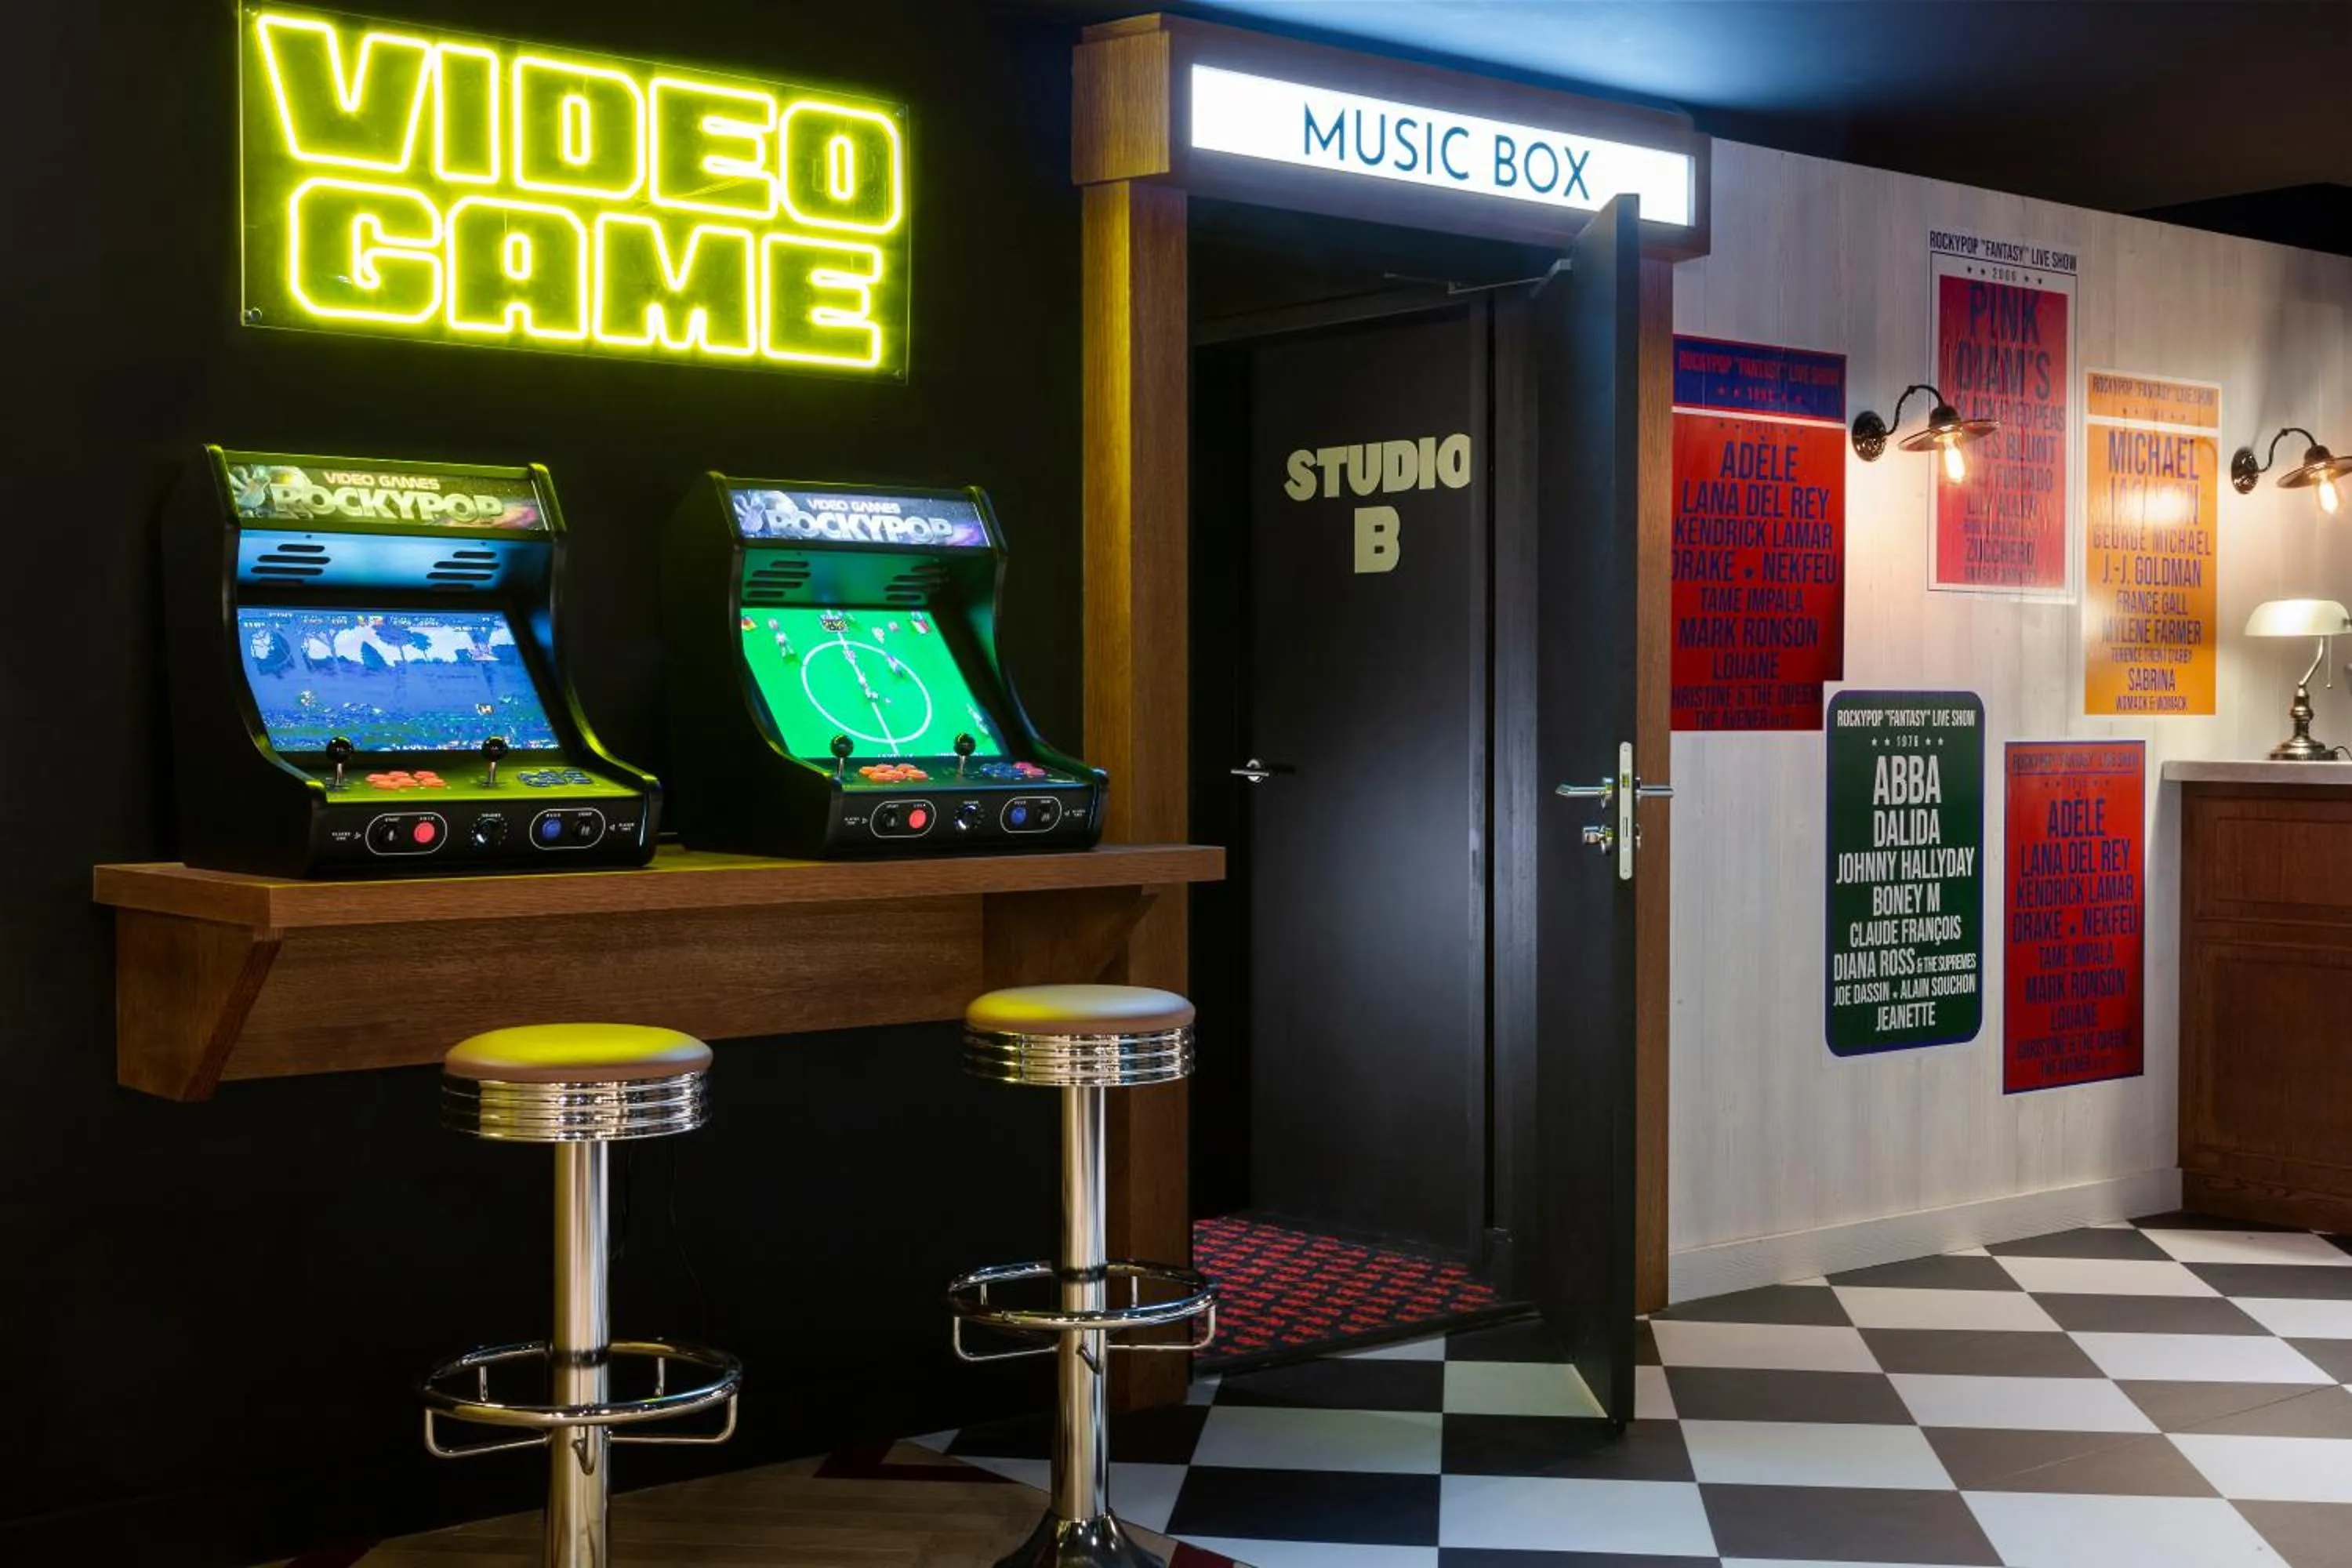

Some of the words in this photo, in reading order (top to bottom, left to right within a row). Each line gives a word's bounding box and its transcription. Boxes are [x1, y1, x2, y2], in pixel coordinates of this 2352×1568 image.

[256, 14, 902, 234] VIDEO
[1305, 102, 1469, 180] MUSIC
[1494, 134, 1591, 200] BOX
[1929, 230, 1979, 254] ROCKYPOP
[2031, 248, 2049, 267] LIVE
[2052, 251, 2077, 271] SHOW
[289, 176, 884, 368] GAME
[1969, 281, 2041, 344] PINK
[1283, 434, 1471, 501] STUDIO
[2109, 430, 2200, 481] MICHAEL
[323, 472, 375, 485] VIDEO
[379, 474, 441, 490] GAMES
[270, 482, 503, 521] ROCKYPOP
[808, 499, 848, 510] VIDEO
[851, 500, 901, 514] GAMES
[1682, 480, 1739, 516] LANA
[1746, 484, 1784, 517] DEL
[1791, 486, 1829, 520] REY
[768, 510, 953, 543] ROCKYPOP
[1355, 506, 1400, 573] B
[1674, 516, 1767, 547] KENDRICK
[1773, 521, 1833, 548] LAMAR
[2152, 528, 2211, 556] MICHAEL
[1762, 552, 1837, 584] NEKFEU
[2135, 555, 2201, 587] GOLDMAN
[1700, 587, 1740, 612] TAME
[1746, 588, 1806, 613] IMPALA
[2117, 590, 2158, 615] FRANCE
[2162, 592, 2188, 615] GALL
[1678, 617, 1737, 648] MARK
[1742, 617, 1819, 649] RONSON
[2154, 619, 2201, 645] FARMER
[1711, 652, 1780, 680] LOUANE
[2128, 668, 2176, 691] SABRINA
[1837, 710, 1882, 728] ROCKYPOP
[1885, 710, 1931, 727] "FANTASY"
[1933, 710, 1950, 727] LIVE
[1951, 710, 1976, 727] SHOW
[1872, 755, 1941, 805] ABBA
[1874, 809, 1941, 848] DALIDA
[1835, 851, 1897, 884] JOHNNY
[1901, 847, 1975, 880] HALLYDAY
[2021, 842, 2063, 877] LANA
[2068, 840, 2096, 874] DEL
[2100, 839, 2131, 873] REY
[1873, 884, 1923, 916] BONEY
[1926, 883, 1940, 912] M
[2016, 877, 2084, 908] KENDRICK
[2089, 874, 2133, 903] LAMAR
[1849, 920, 1898, 947] CLAUDE
[1901, 916, 1962, 946] FRANÇOIS
[2013, 910, 2063, 943] DRAKE
[2082, 904, 2137, 936] NEKFEU
[1834, 951, 1876, 981] DIANA
[1880, 947, 1915, 976] ROSS
[1923, 956, 1936, 972] THE
[1938, 953, 1976, 971] SUPREMES
[1833, 985, 1851, 1007] JOE
[1853, 981, 1889, 1004] DASSIN
[1900, 978, 1929, 999] ALAIN
[1931, 973, 1976, 996] SOUCHON
[2025, 973, 2065, 1004] MARK
[2071, 968, 2126, 1000] RONSON
[1875, 1002, 1936, 1032] JEANETTE
